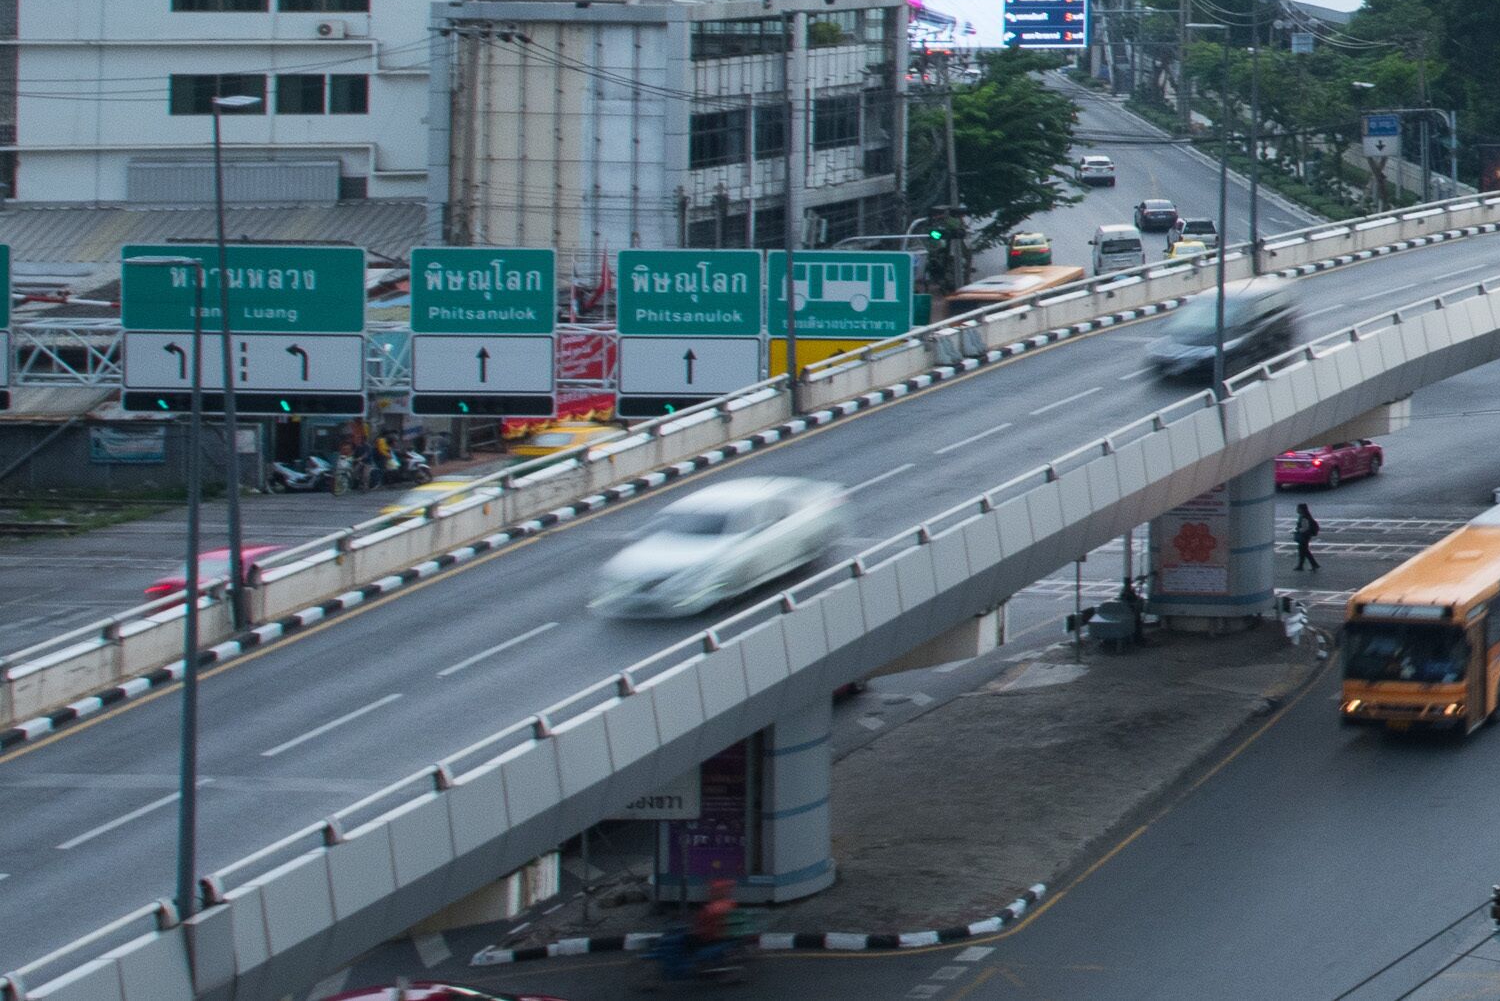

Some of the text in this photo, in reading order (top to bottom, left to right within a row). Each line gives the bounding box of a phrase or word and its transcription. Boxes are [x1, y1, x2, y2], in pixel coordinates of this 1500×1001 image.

[424, 259, 542, 301] พิษณุโลก
[631, 261, 748, 303] พิษณุโลก
[243, 306, 298, 322] Luang
[428, 306, 536, 320] Phitsanulok
[635, 308, 743, 323] Phitsanulok
